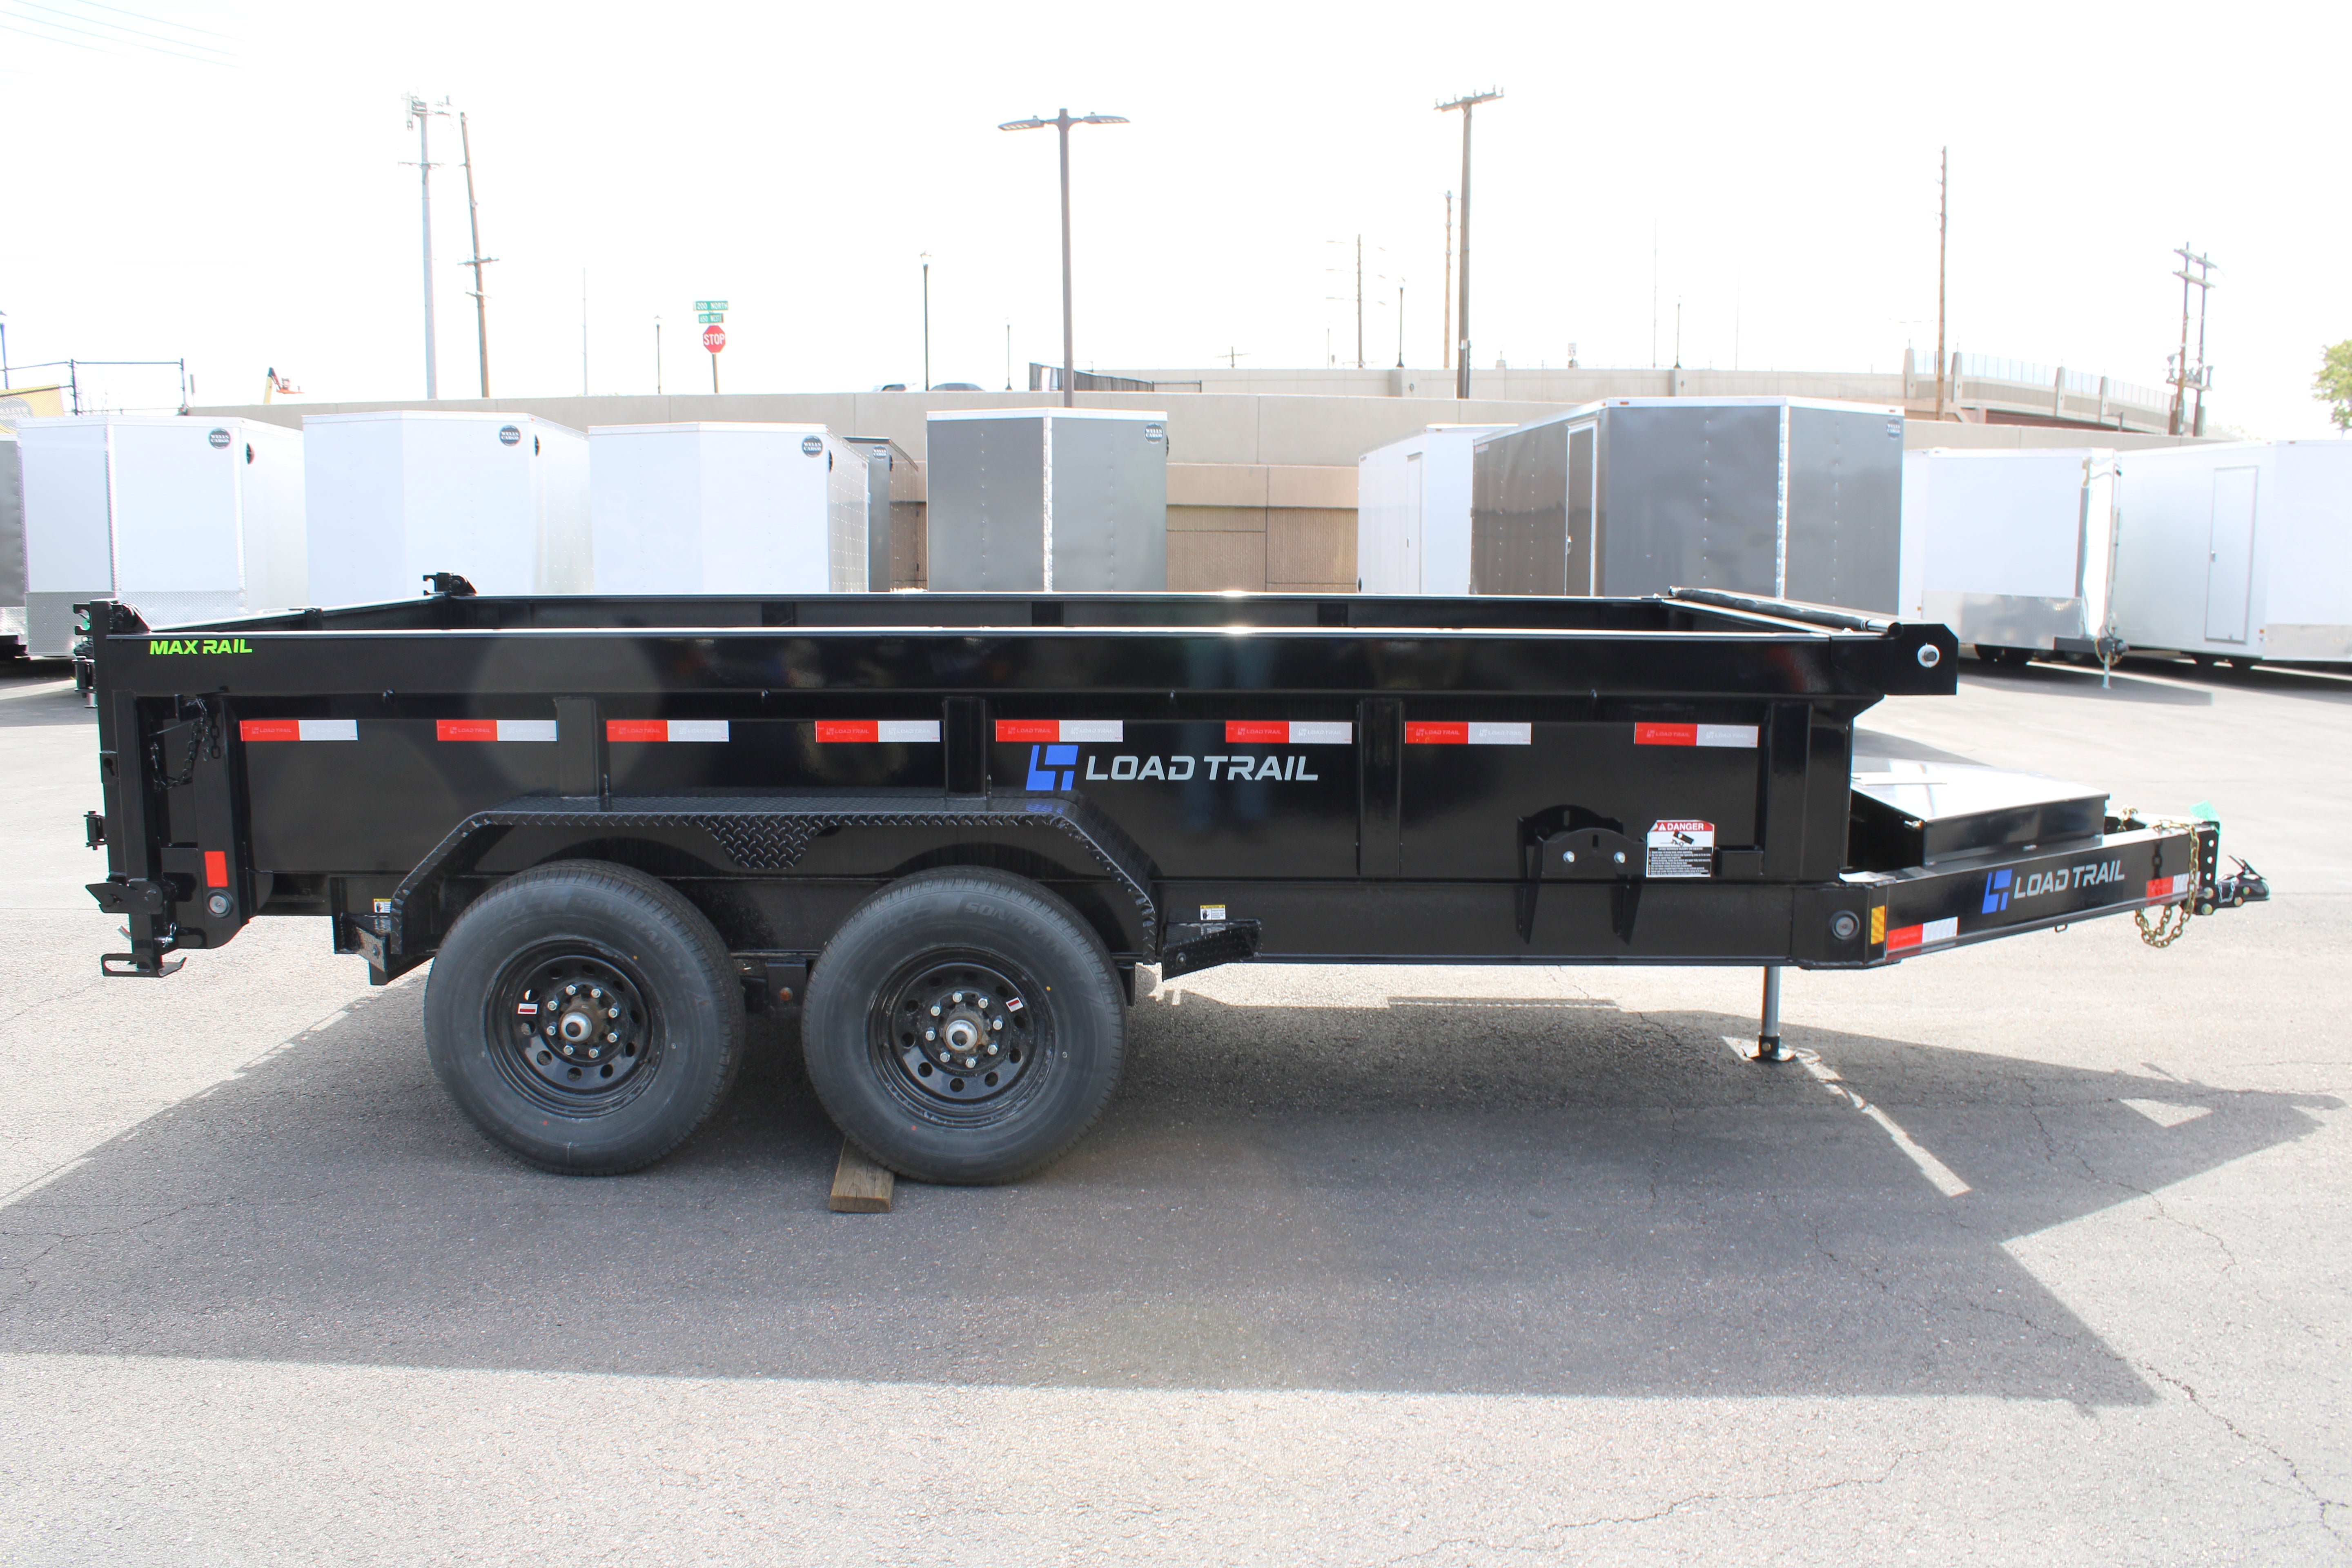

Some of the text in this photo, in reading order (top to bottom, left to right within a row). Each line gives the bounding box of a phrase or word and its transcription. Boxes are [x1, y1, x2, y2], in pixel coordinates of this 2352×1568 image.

[704, 333, 725, 345] STOP
[150, 639, 253, 655] MAX RAIL
[1086, 755, 1318, 780] LOAD TRAIL
[2013, 860, 2125, 899] LOAD TRAIL
